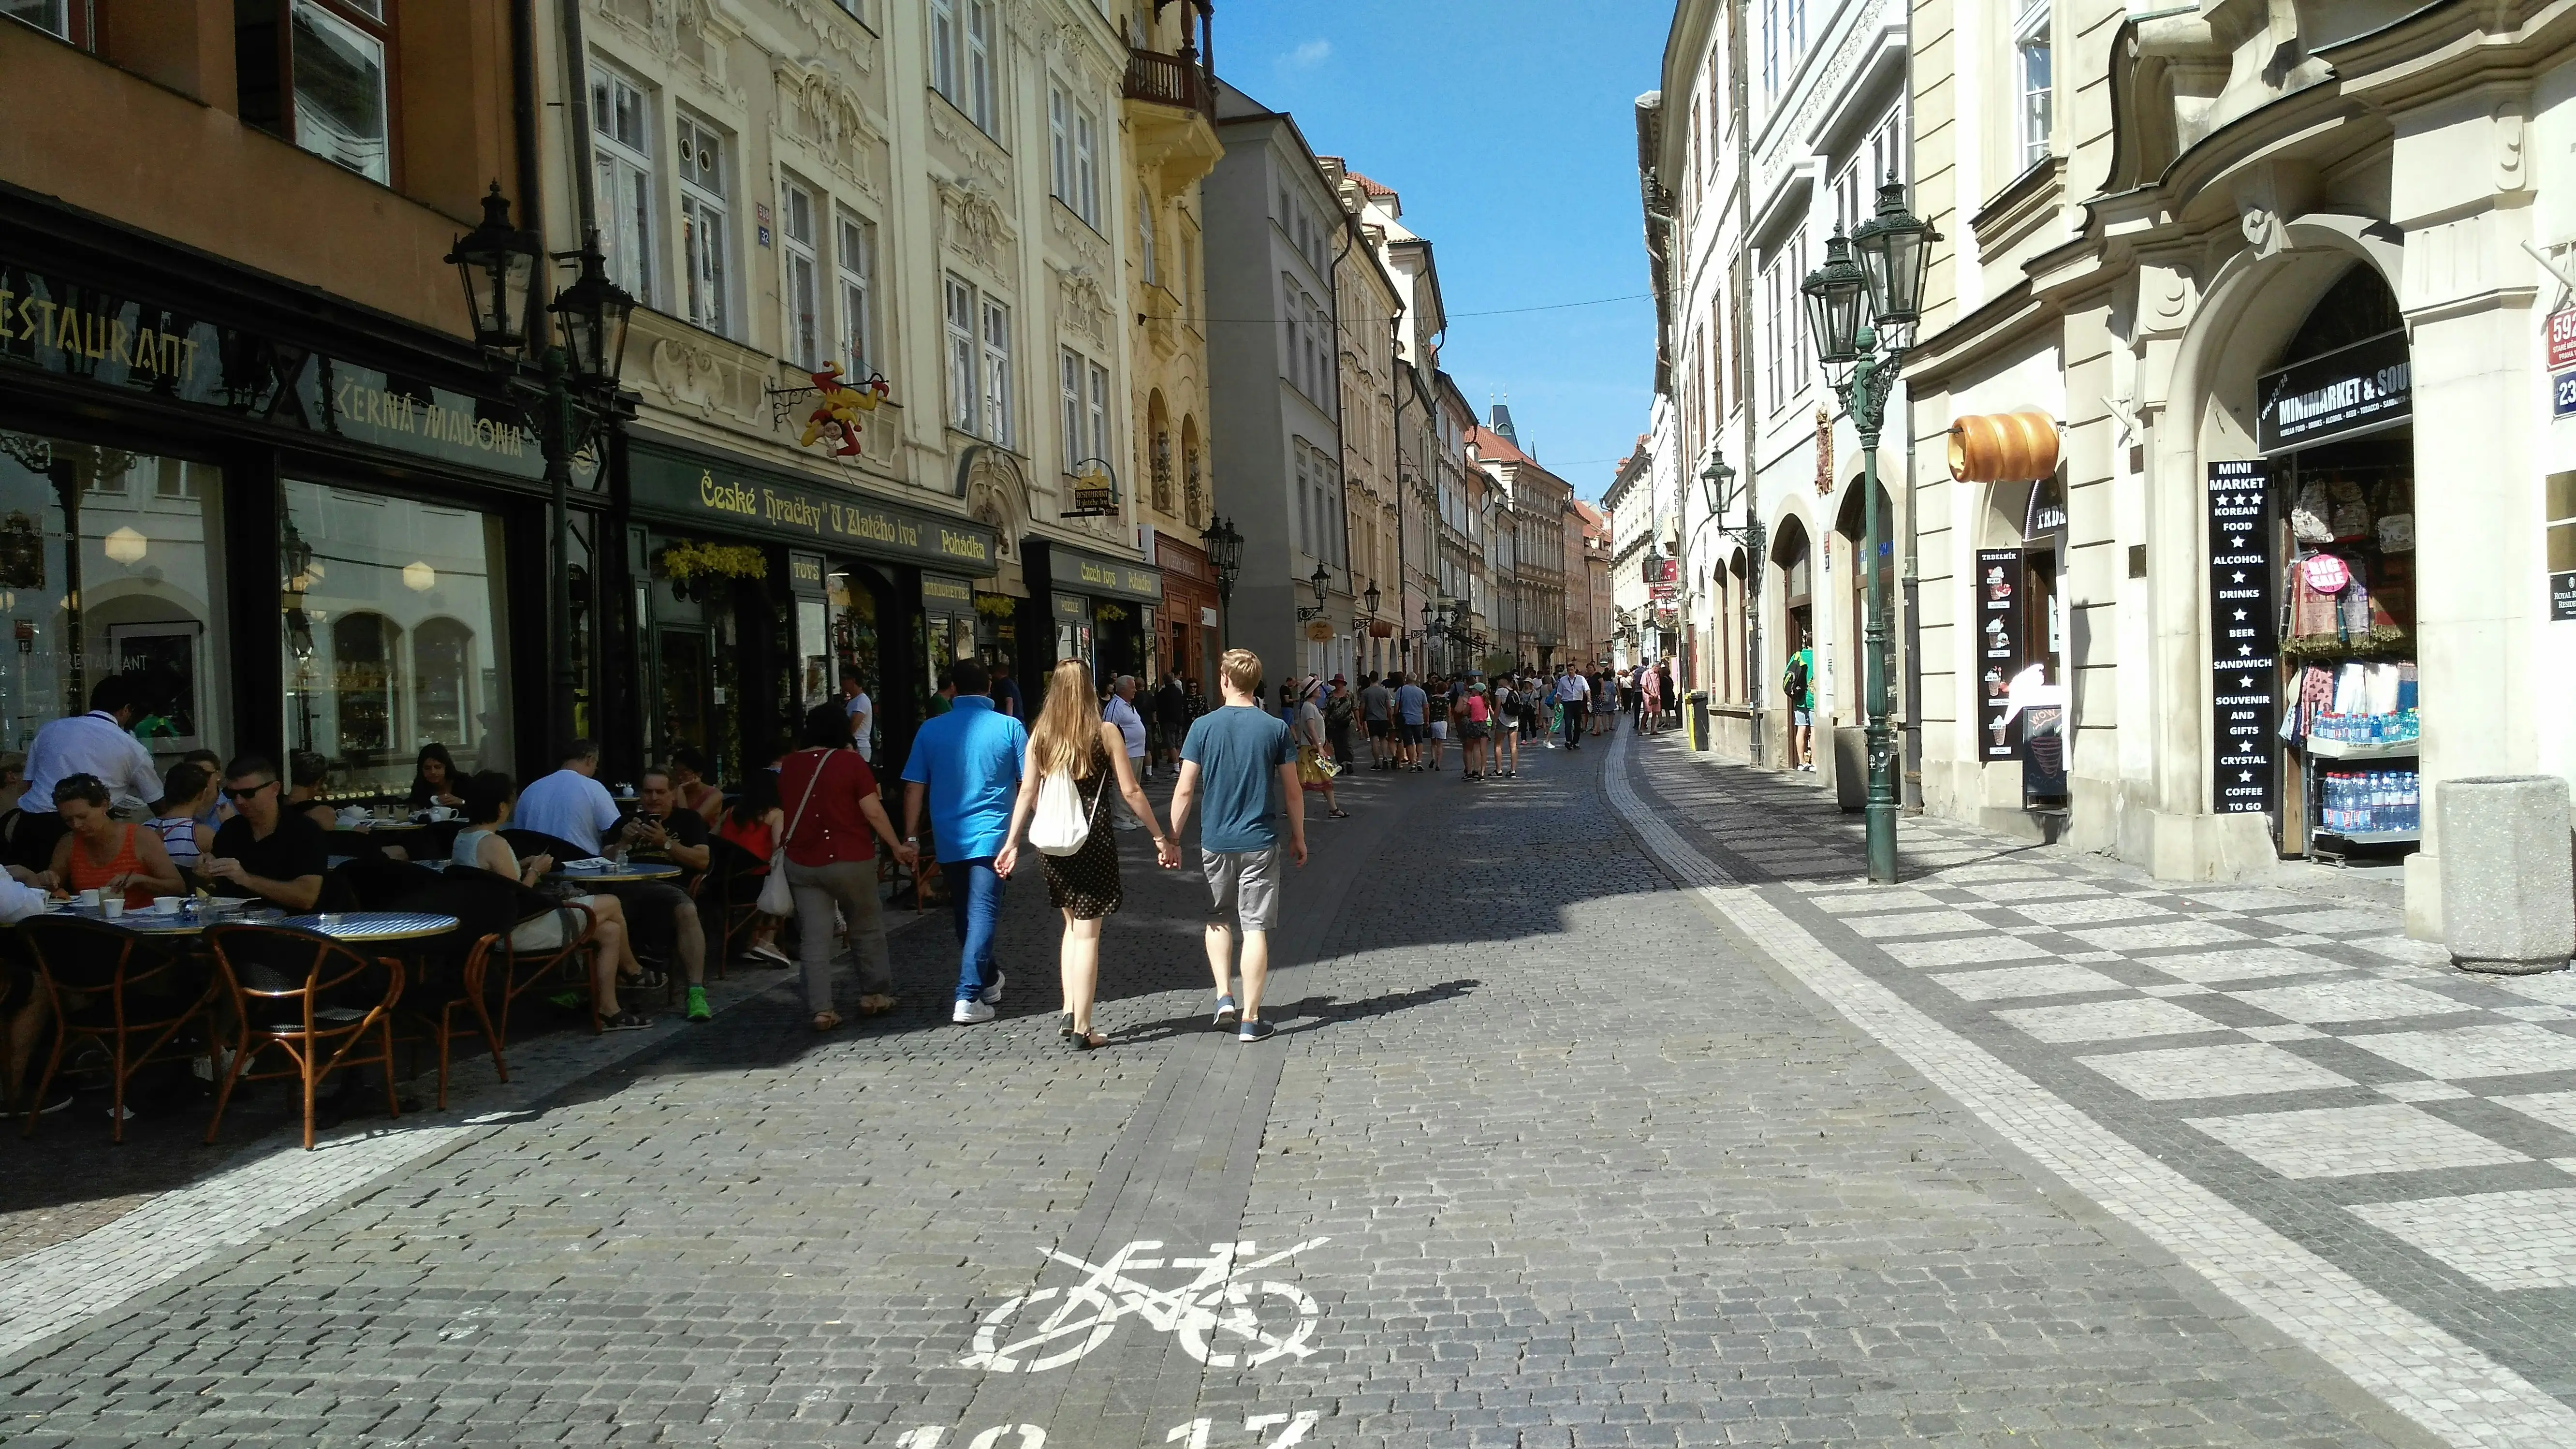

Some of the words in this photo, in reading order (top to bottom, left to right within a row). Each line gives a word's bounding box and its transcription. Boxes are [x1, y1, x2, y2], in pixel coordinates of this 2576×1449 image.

[761, 231, 769, 243] 32
[2279, 377, 2361, 425] MINIMARKET
[2364, 378, 2375, 401] &
[338, 376, 414, 433] ČERNÁ
[424, 404, 523, 457] MADONA
[2219, 463, 2251, 474] MINI
[2210, 478, 2265, 490] MARKET
[1076, 490, 1108, 498] RESTAURANT
[701, 468, 757, 515] České
[846, 508, 895, 542] Zlatého
[2214, 507, 2258, 516] KOREAN
[2223, 522, 2253, 531] FOOD
[941, 529, 985, 560] Pohádka
[1981, 552, 2016, 560] TRDELNÍK
[2213, 555, 2264, 564] ALCOHOL
[2308, 558, 2341, 574] BIG
[793, 562, 819, 581] TOYS
[1081, 562, 1101, 583] Czech
[1103, 567, 1116, 588] toys
[2311, 572, 2345, 587] SALE
[923, 582, 970, 600] MARIONETTES
[2219, 589, 2259, 599] DRINKS
[2554, 592, 2572, 600] ROYAL
[1061, 600, 1079, 613] PUZZLE
[2229, 629, 2255, 638] BEER
[2214, 659, 2272, 669] SANDWICH
[2216, 696, 2270, 705] SOUVENIR
[2230, 711, 2254, 720] AND
[2229, 726, 2259, 735] GIFTS
[2221, 756, 2267, 765] CRYSTAL
[2225, 788, 2263, 796] COFFEE
